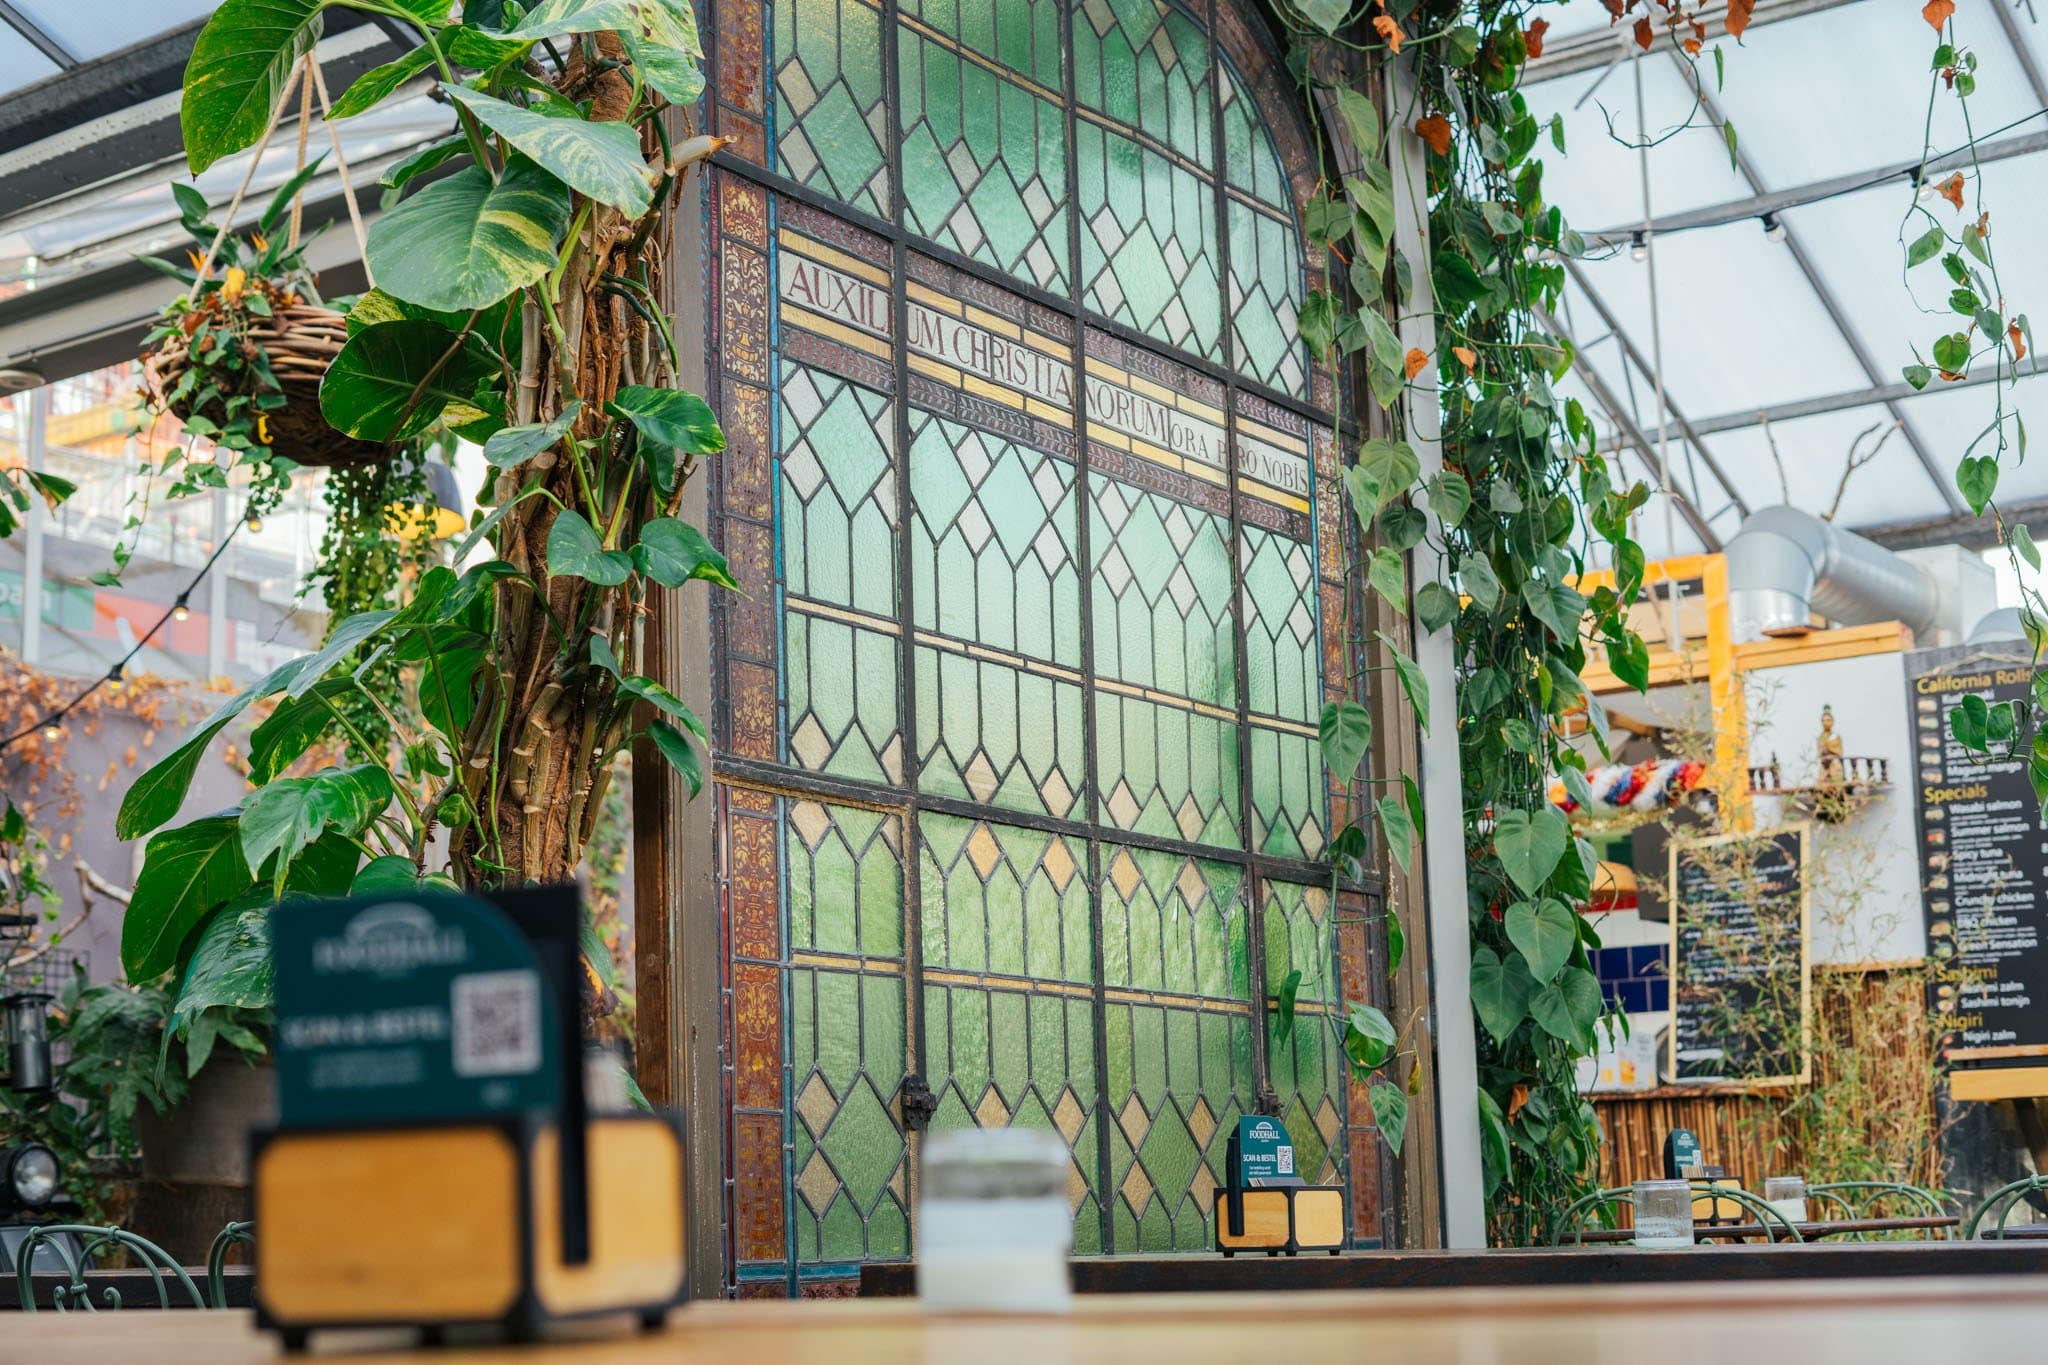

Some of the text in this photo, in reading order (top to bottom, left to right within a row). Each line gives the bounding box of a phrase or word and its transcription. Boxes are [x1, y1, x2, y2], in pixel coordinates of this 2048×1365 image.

[1171, 423, 1209, 459] ORA
[1262, 454, 1308, 494] NOBIS
[1917, 669, 2030, 694] California Rolls
[1986, 761, 2023, 774] mango
[1924, 783, 1988, 804] Specials
[1949, 800, 2023, 815] Wasabi salmon
[1950, 826, 1992, 838] Summer
[1993, 822, 2030, 834] salmon
[1952, 848, 2003, 861] Spicy tuna
[1997, 892, 2035, 904] chicken
[1989, 938, 2038, 950] Sensation
[2000, 981, 2024, 992] zalm
[1960, 996, 1999, 1008] Sashimi
[1962, 1029, 2017, 1043] Nigiri zalm
